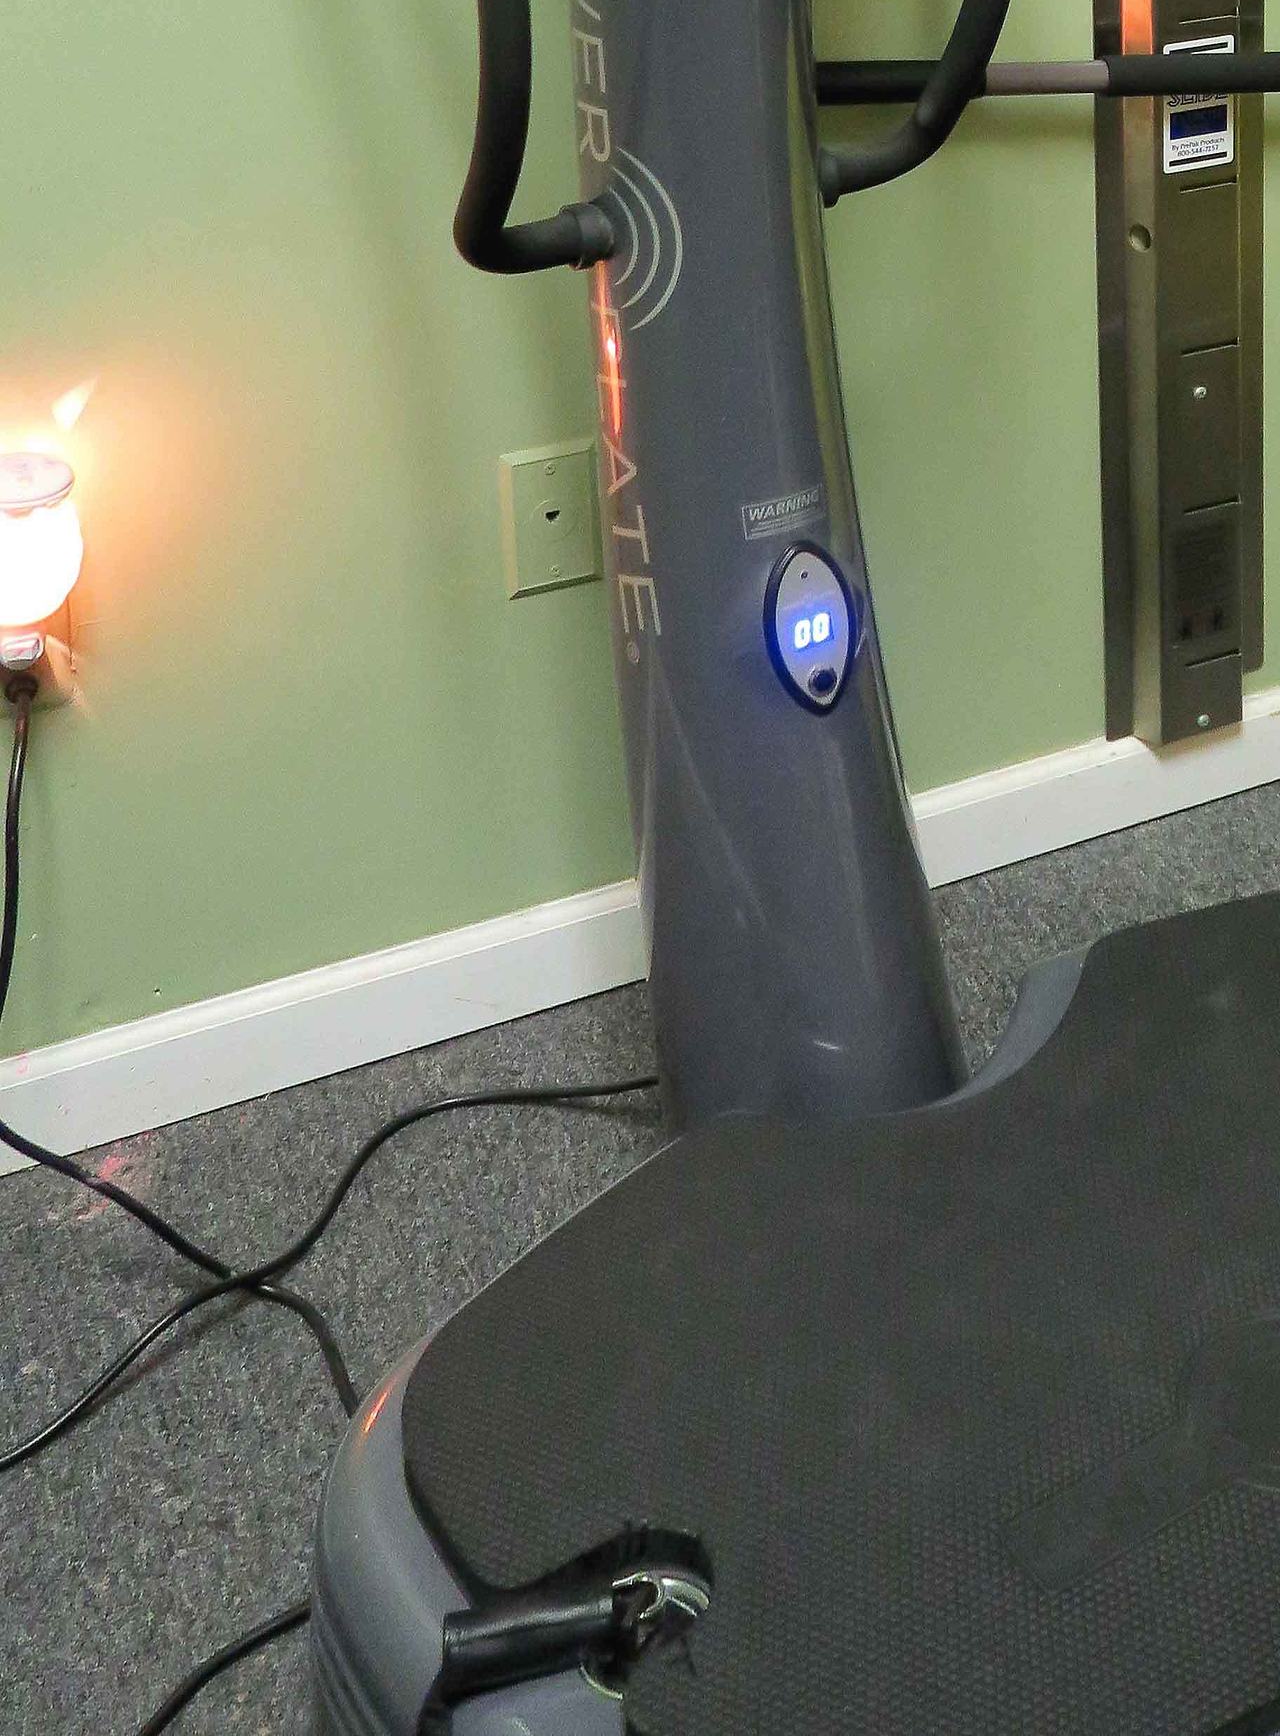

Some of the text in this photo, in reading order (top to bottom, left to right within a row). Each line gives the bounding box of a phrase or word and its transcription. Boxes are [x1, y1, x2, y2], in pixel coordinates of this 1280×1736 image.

[1200, 136, 1225, 146] Products
[591, 301, 662, 636] PLATE
[749, 489, 821, 521] WARNING
